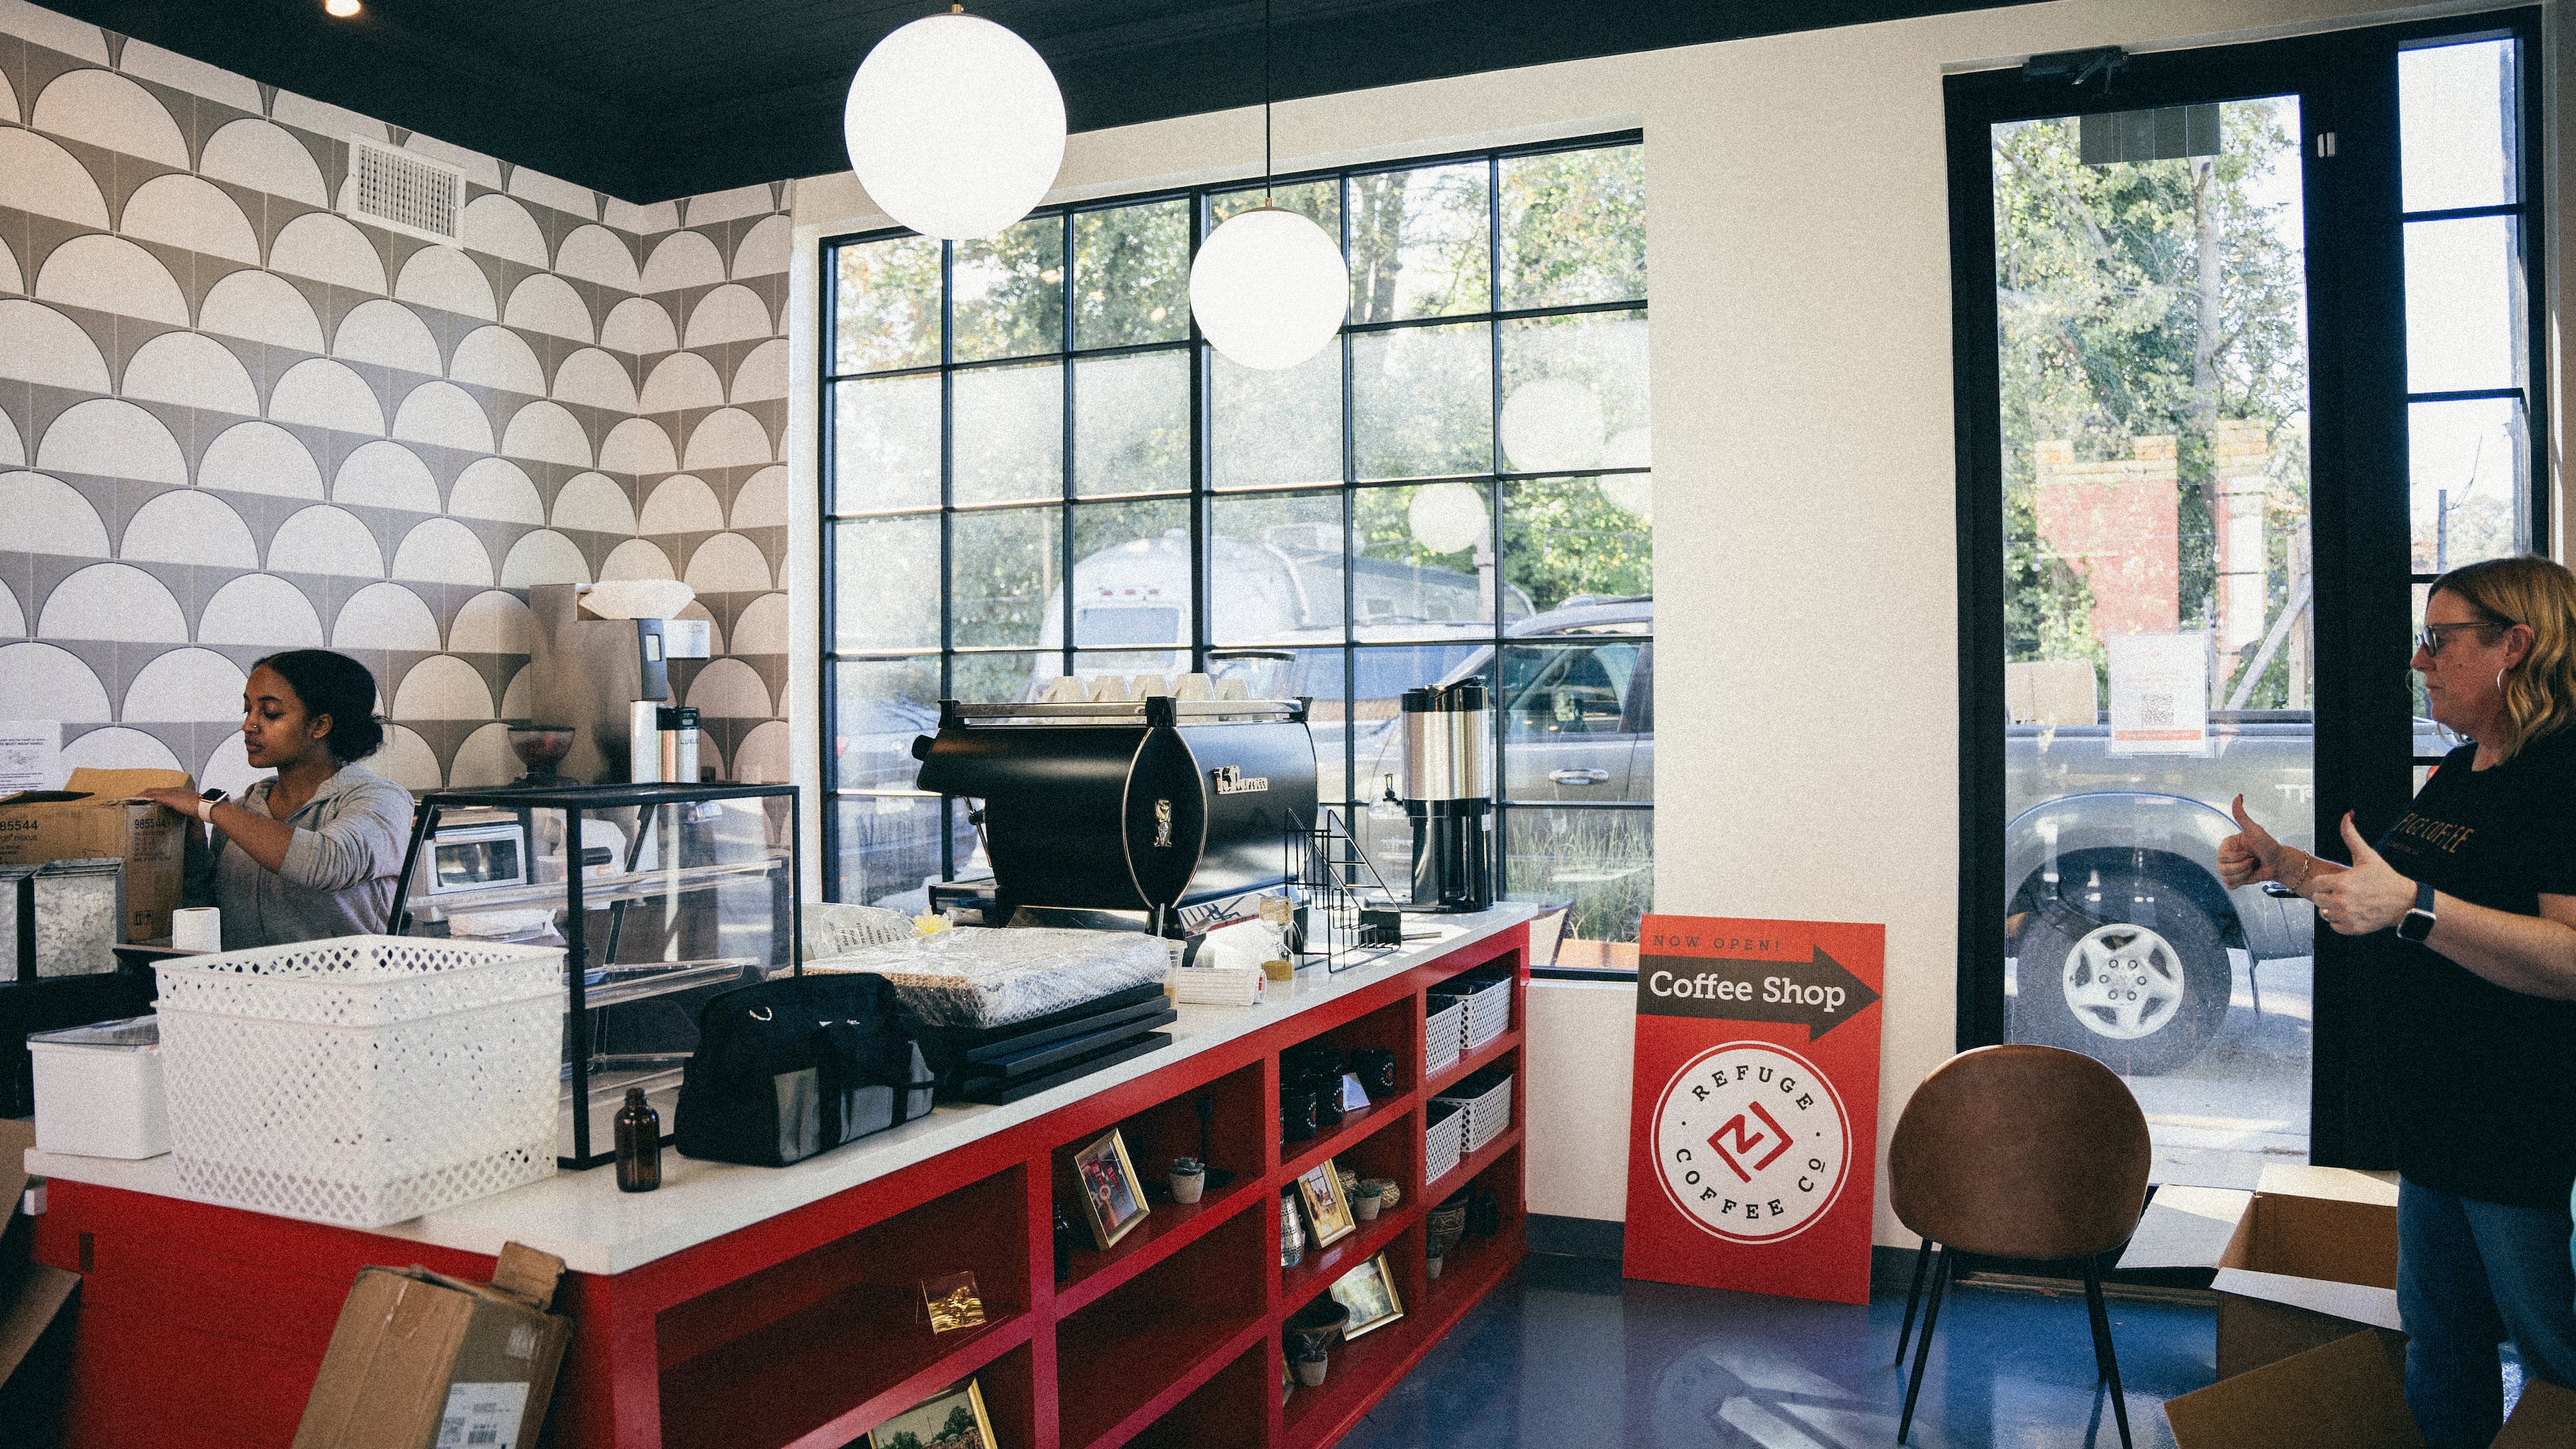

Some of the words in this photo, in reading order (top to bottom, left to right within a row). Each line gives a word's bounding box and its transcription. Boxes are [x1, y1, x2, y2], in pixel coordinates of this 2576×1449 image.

[1653, 935, 1700, 948] NOW
[1713, 938, 1779, 952] OPEN!
[1650, 970, 1753, 1002] Coffee
[1762, 976, 1845, 1013] Shop
[1691, 1065, 1814, 1111] REFUGE
[1676, 1148, 1784, 1219] COFFEE
